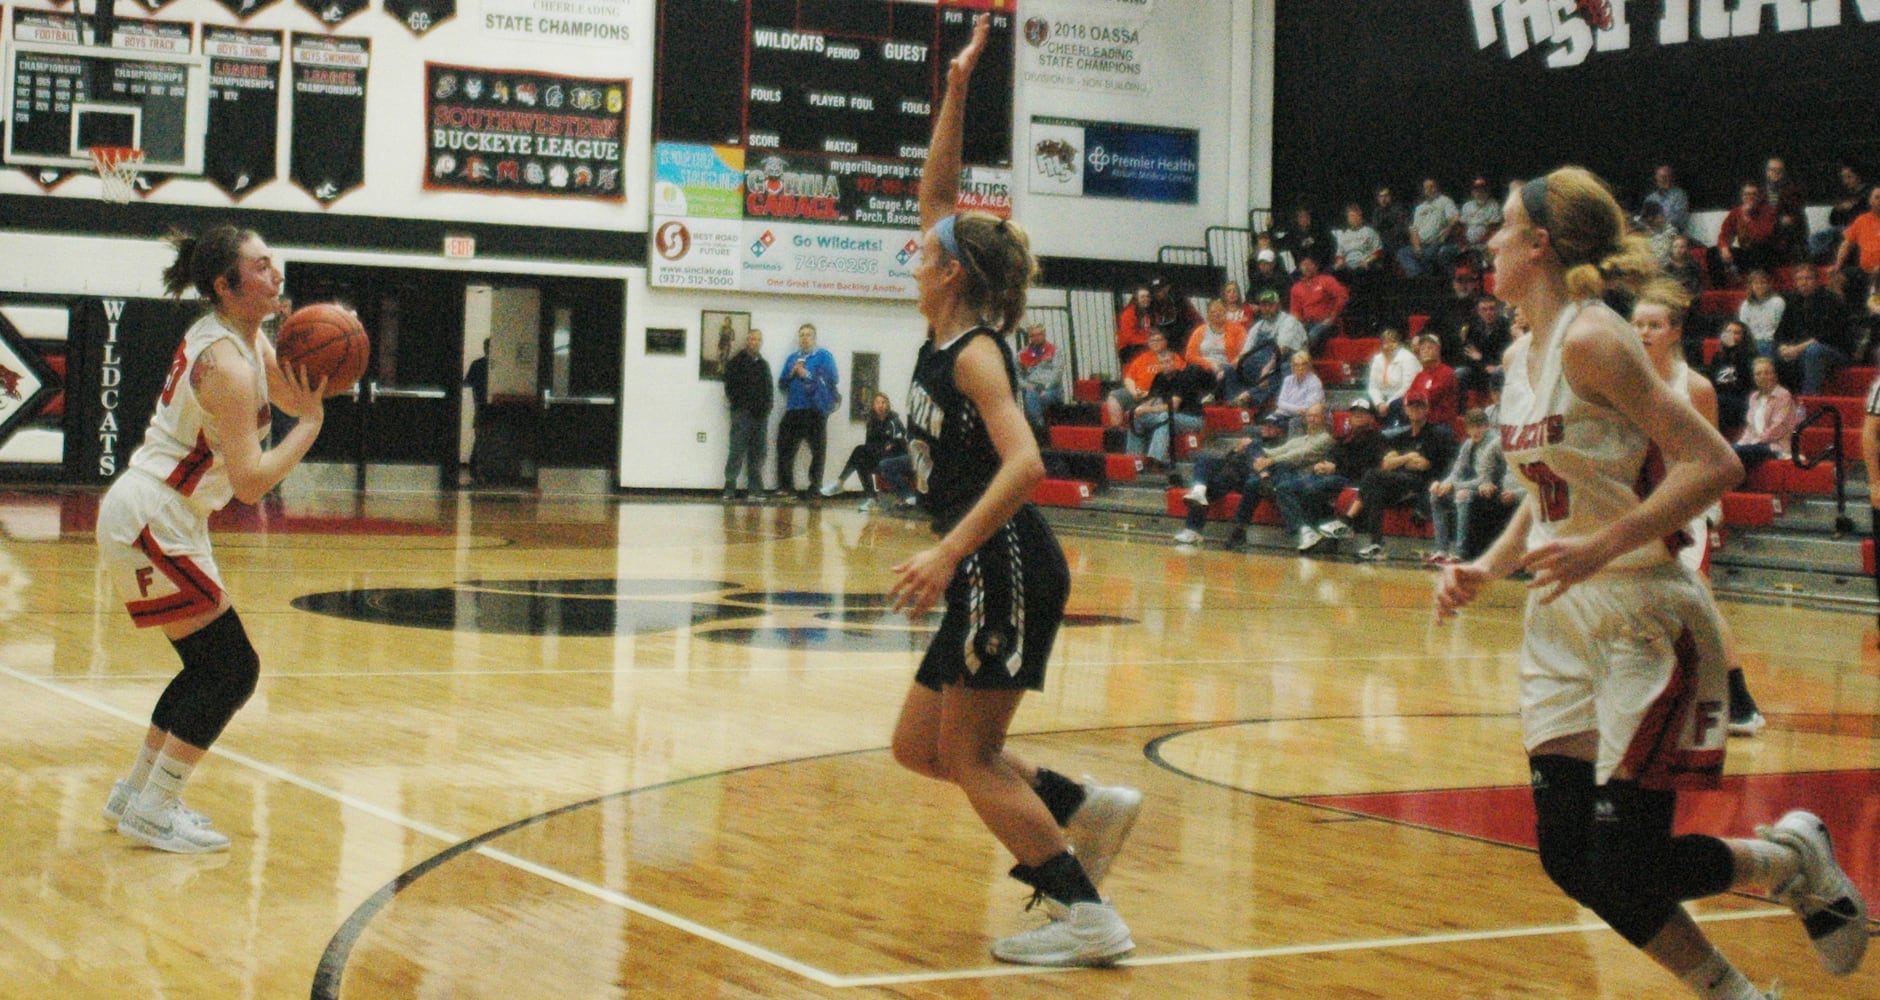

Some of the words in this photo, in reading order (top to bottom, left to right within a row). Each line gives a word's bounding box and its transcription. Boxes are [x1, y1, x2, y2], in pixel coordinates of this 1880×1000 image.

[485, 13, 534, 33] STATE
[539, 18, 630, 41] CHAMPIONS
[993, 16, 1008, 28] PTS
[34, 29, 77, 42] FOOTBALL
[1054, 22, 1087, 38] 2018
[1089, 26, 1140, 45] OASSA
[124, 36, 148, 47] BOYS
[755, 31, 824, 52] WILDCATS
[826, 47, 861, 60] PERIOD
[884, 43, 929, 62] GUEST
[1047, 41, 1134, 61] CHEERLEADING
[1038, 54, 1074, 69] STATE
[1076, 58, 1142, 75] CHAMPIONS
[114, 68, 184, 83] CHAMPIONSHIPS
[296, 82, 363, 96] CHAMPIONSHIPS
[750, 88, 782, 103] FOULS
[810, 94, 846, 108] PLAYER
[850, 97, 875, 111] FOUL
[901, 101, 931, 115] FOULS
[433, 105, 619, 139] SOUTHWESTERN
[434, 129, 532, 154] BUCKEYE
[537, 136, 619, 160] LEAGUE
[748, 134, 780, 148] SCORE
[824, 140, 859, 153] MATCH
[899, 146, 929, 160] SCORE
[1112, 154, 1155, 169] Premier
[1157, 157, 1196, 172] Health
[980, 194, 1010, 207] AREA
[856, 209, 885, 224] Porch,
[693, 232, 713, 241] BEST
[715, 234, 738, 242] ROAD
[792, 234, 813, 247] Go
[816, 235, 882, 251] Wildcats!
[699, 247, 730, 256] FUTURE
[660, 265, 734, 277] www.sinclair.edu
[687, 275, 734, 286] 512-3000
[766, 278, 785, 287] One
[837, 282, 871, 293] Backing
[98, 299, 126, 477] WILDCATS
[135, 566, 153, 598] F
[1693, 700, 1722, 747] F
